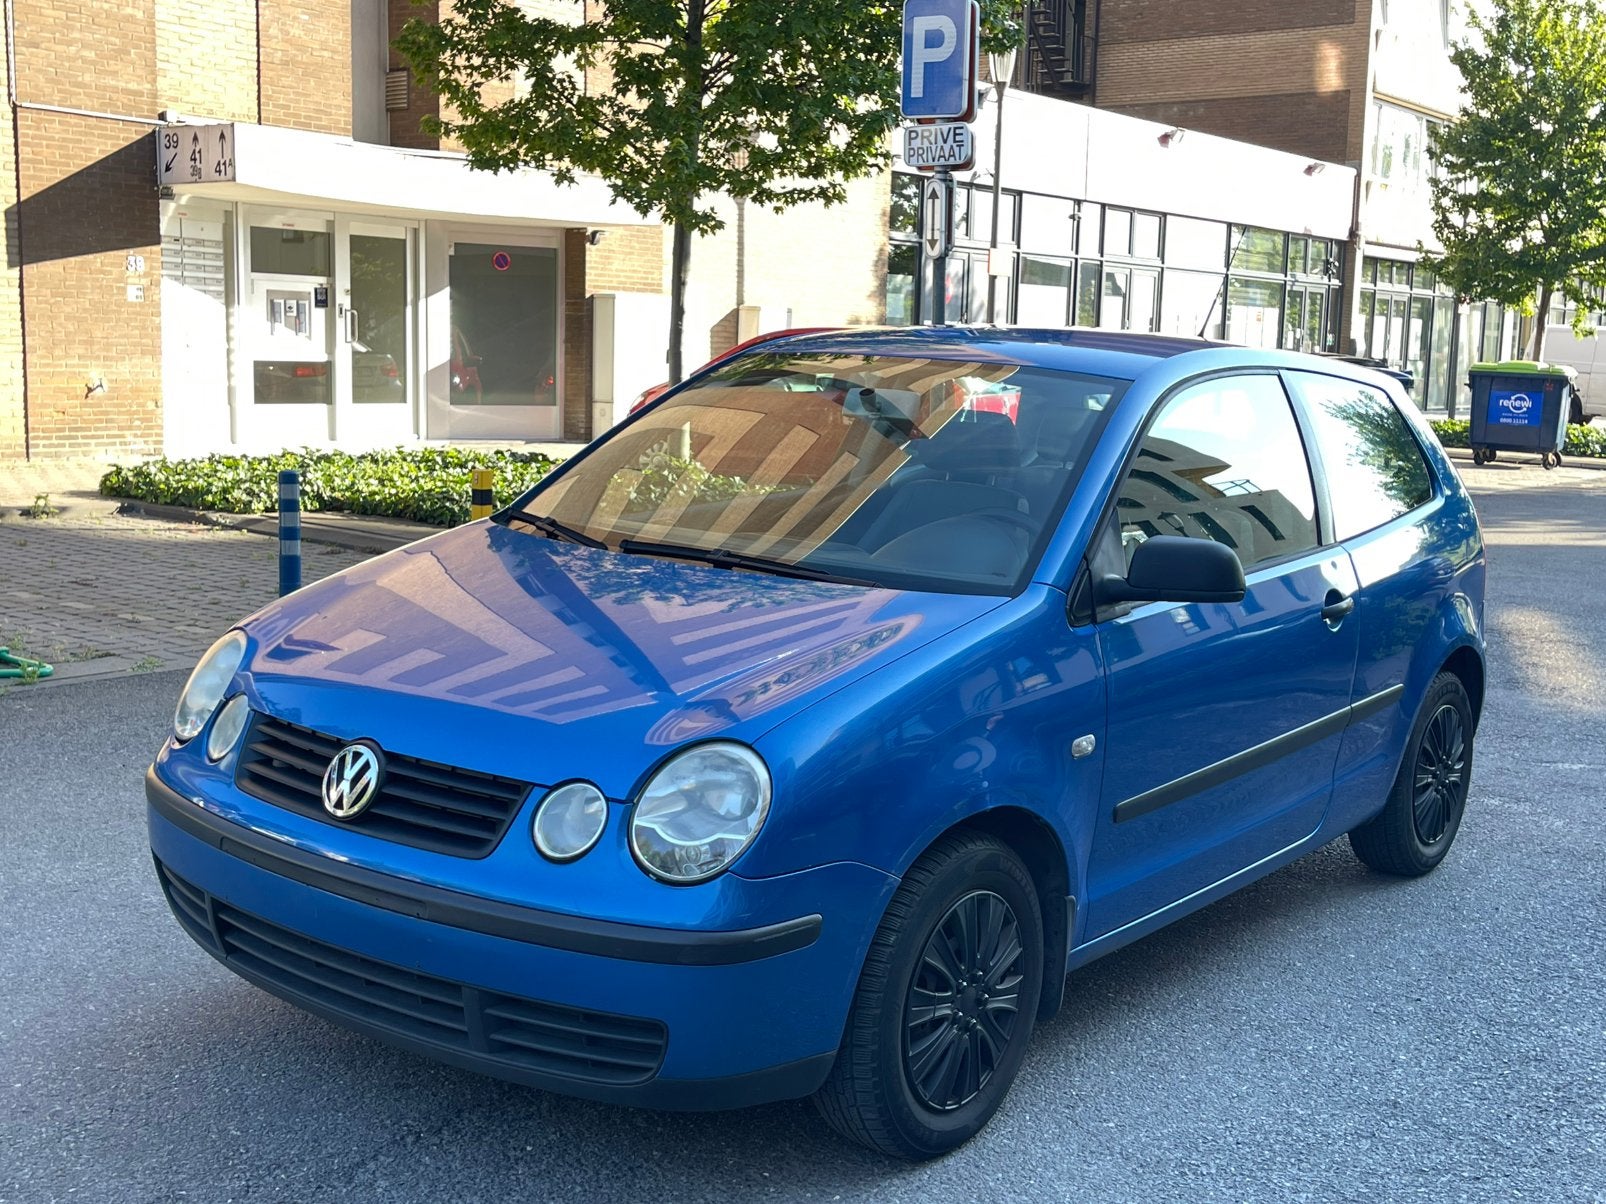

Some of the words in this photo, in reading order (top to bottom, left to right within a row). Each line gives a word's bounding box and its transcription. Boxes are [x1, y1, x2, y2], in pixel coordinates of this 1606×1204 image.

[911, 15, 957, 98] P
[164, 132, 179, 149] 39
[907, 126, 965, 146] PRIVE
[189, 147, 202, 165] 41
[907, 144, 965, 164] PRIVAAT
[1499, 397, 1532, 410] renewi
[325, 746, 376, 815] VW
